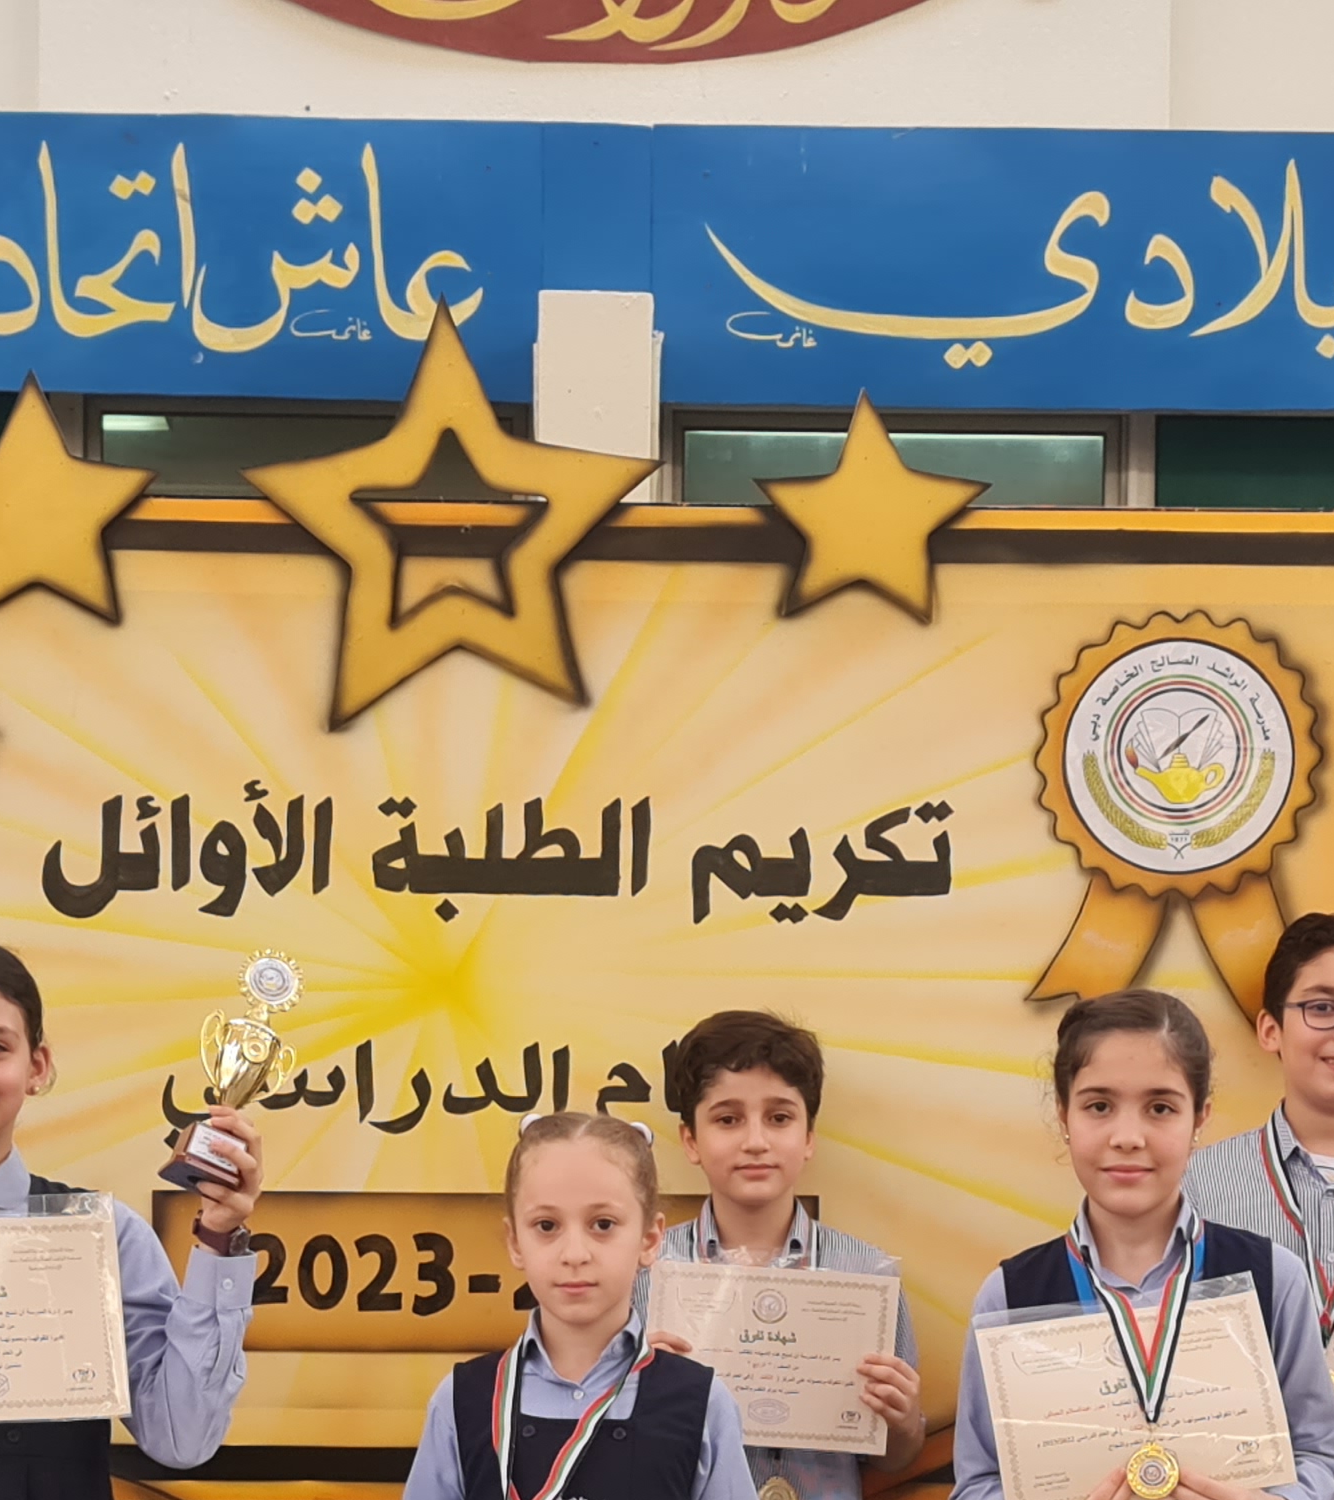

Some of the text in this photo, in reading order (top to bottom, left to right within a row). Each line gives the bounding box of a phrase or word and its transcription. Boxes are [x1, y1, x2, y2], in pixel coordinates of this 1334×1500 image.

[192, 142, 484, 353] عاش
[1096, 663, 1145, 707] الخاصة
[1150, 654, 1200, 673] الصالح
[1207, 662, 1249, 692] الراشد
[1249, 692, 1272, 741] مدرسة
[42, 779, 953, 924] تكريم الطلبة الأوائل
